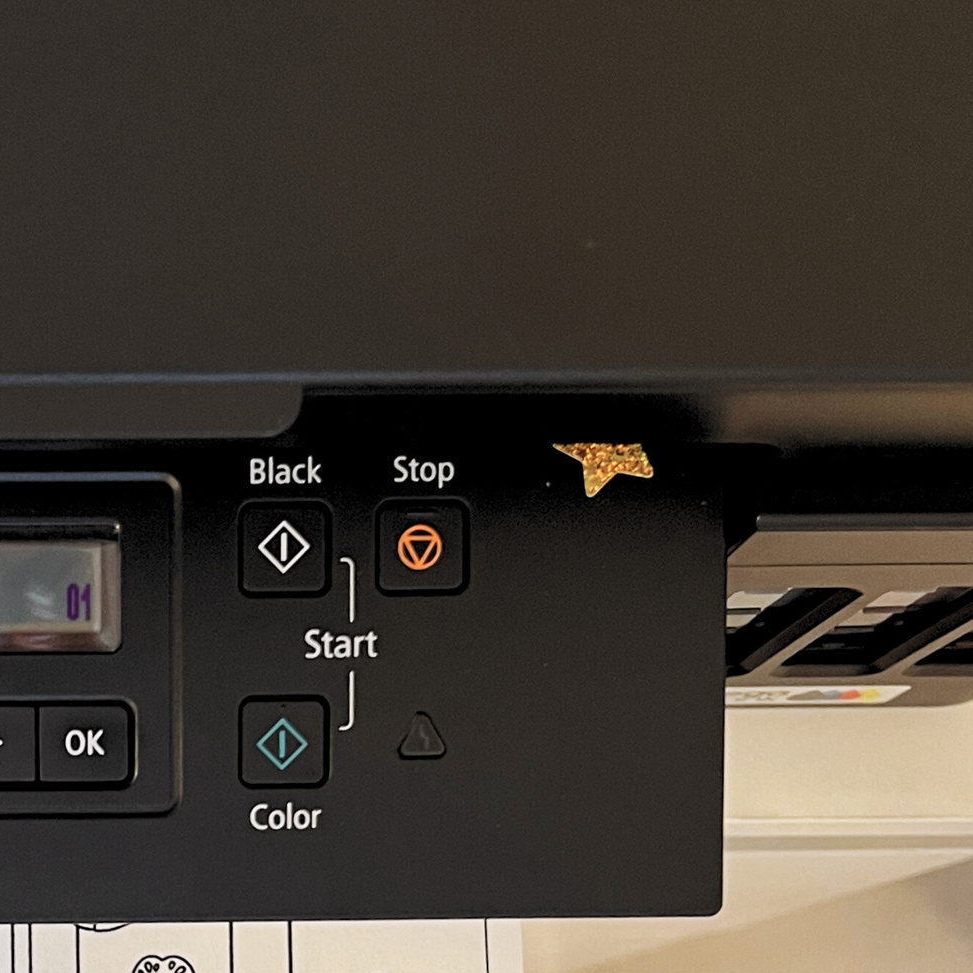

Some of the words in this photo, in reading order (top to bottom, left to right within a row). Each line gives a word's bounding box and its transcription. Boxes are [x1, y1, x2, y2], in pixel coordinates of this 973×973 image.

[249, 456, 322, 485] Black
[393, 456, 455, 489] Stop
[65, 583, 93, 622] 01
[304, 629, 378, 659] Start
[65, 729, 105, 757] OK
[249, 802, 322, 832] Color
